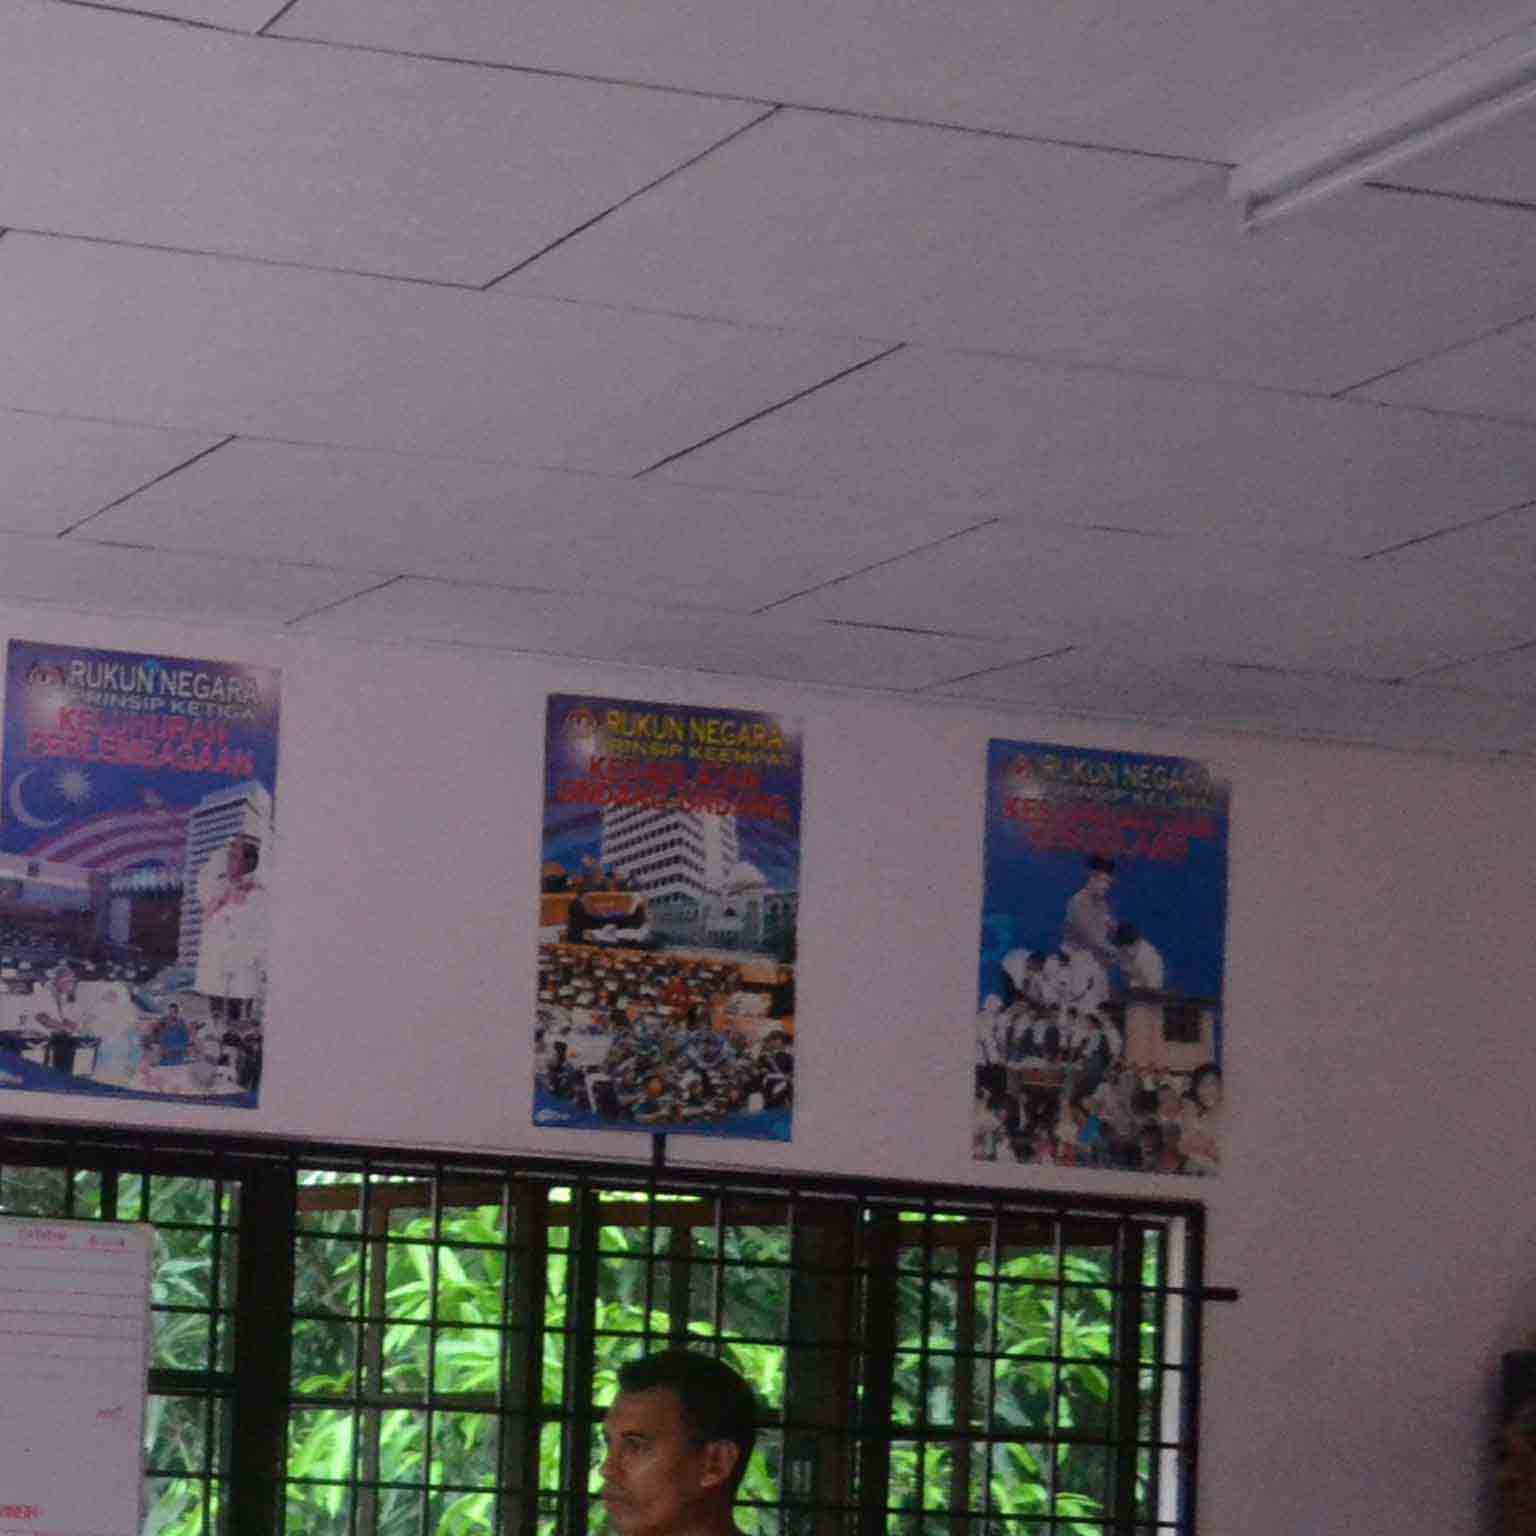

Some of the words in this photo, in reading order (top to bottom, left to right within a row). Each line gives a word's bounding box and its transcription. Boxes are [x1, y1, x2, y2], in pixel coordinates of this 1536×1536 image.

[71, 659, 153, 692] RUKUN
[159, 668, 260, 704] NEGARA
[606, 709, 684, 741] RUKUN
[688, 716, 787, 750] NEGARA
